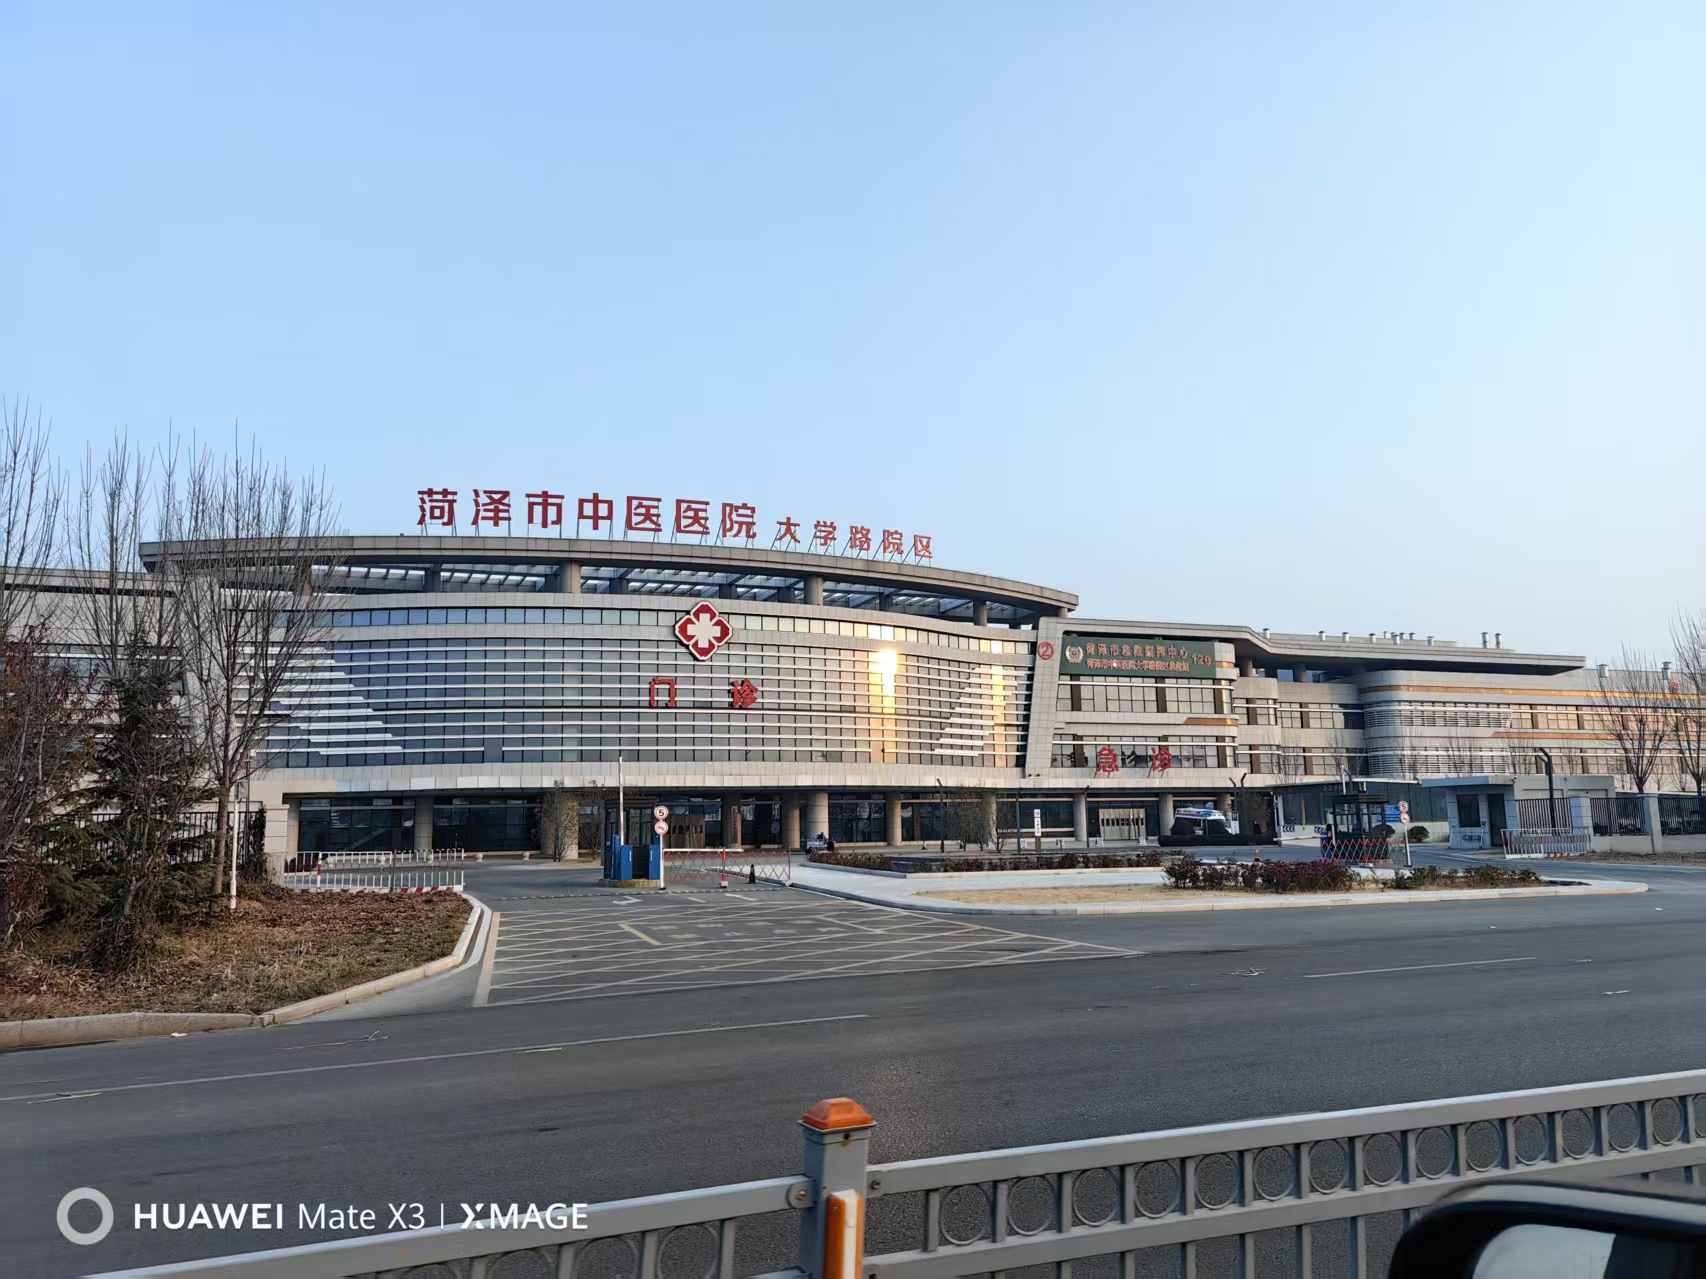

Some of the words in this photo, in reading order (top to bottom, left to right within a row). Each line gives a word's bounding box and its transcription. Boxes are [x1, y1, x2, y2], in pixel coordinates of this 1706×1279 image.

[417, 488, 757, 539] 菏泽市中医医院
[776, 516, 933, 559] 大学路院区
[1192, 653, 1211, 666] 120
[649, 677, 759, 708] 门诊
[1097, 746, 1172, 773] 急诊
[659, 809, 665, 817] 5
